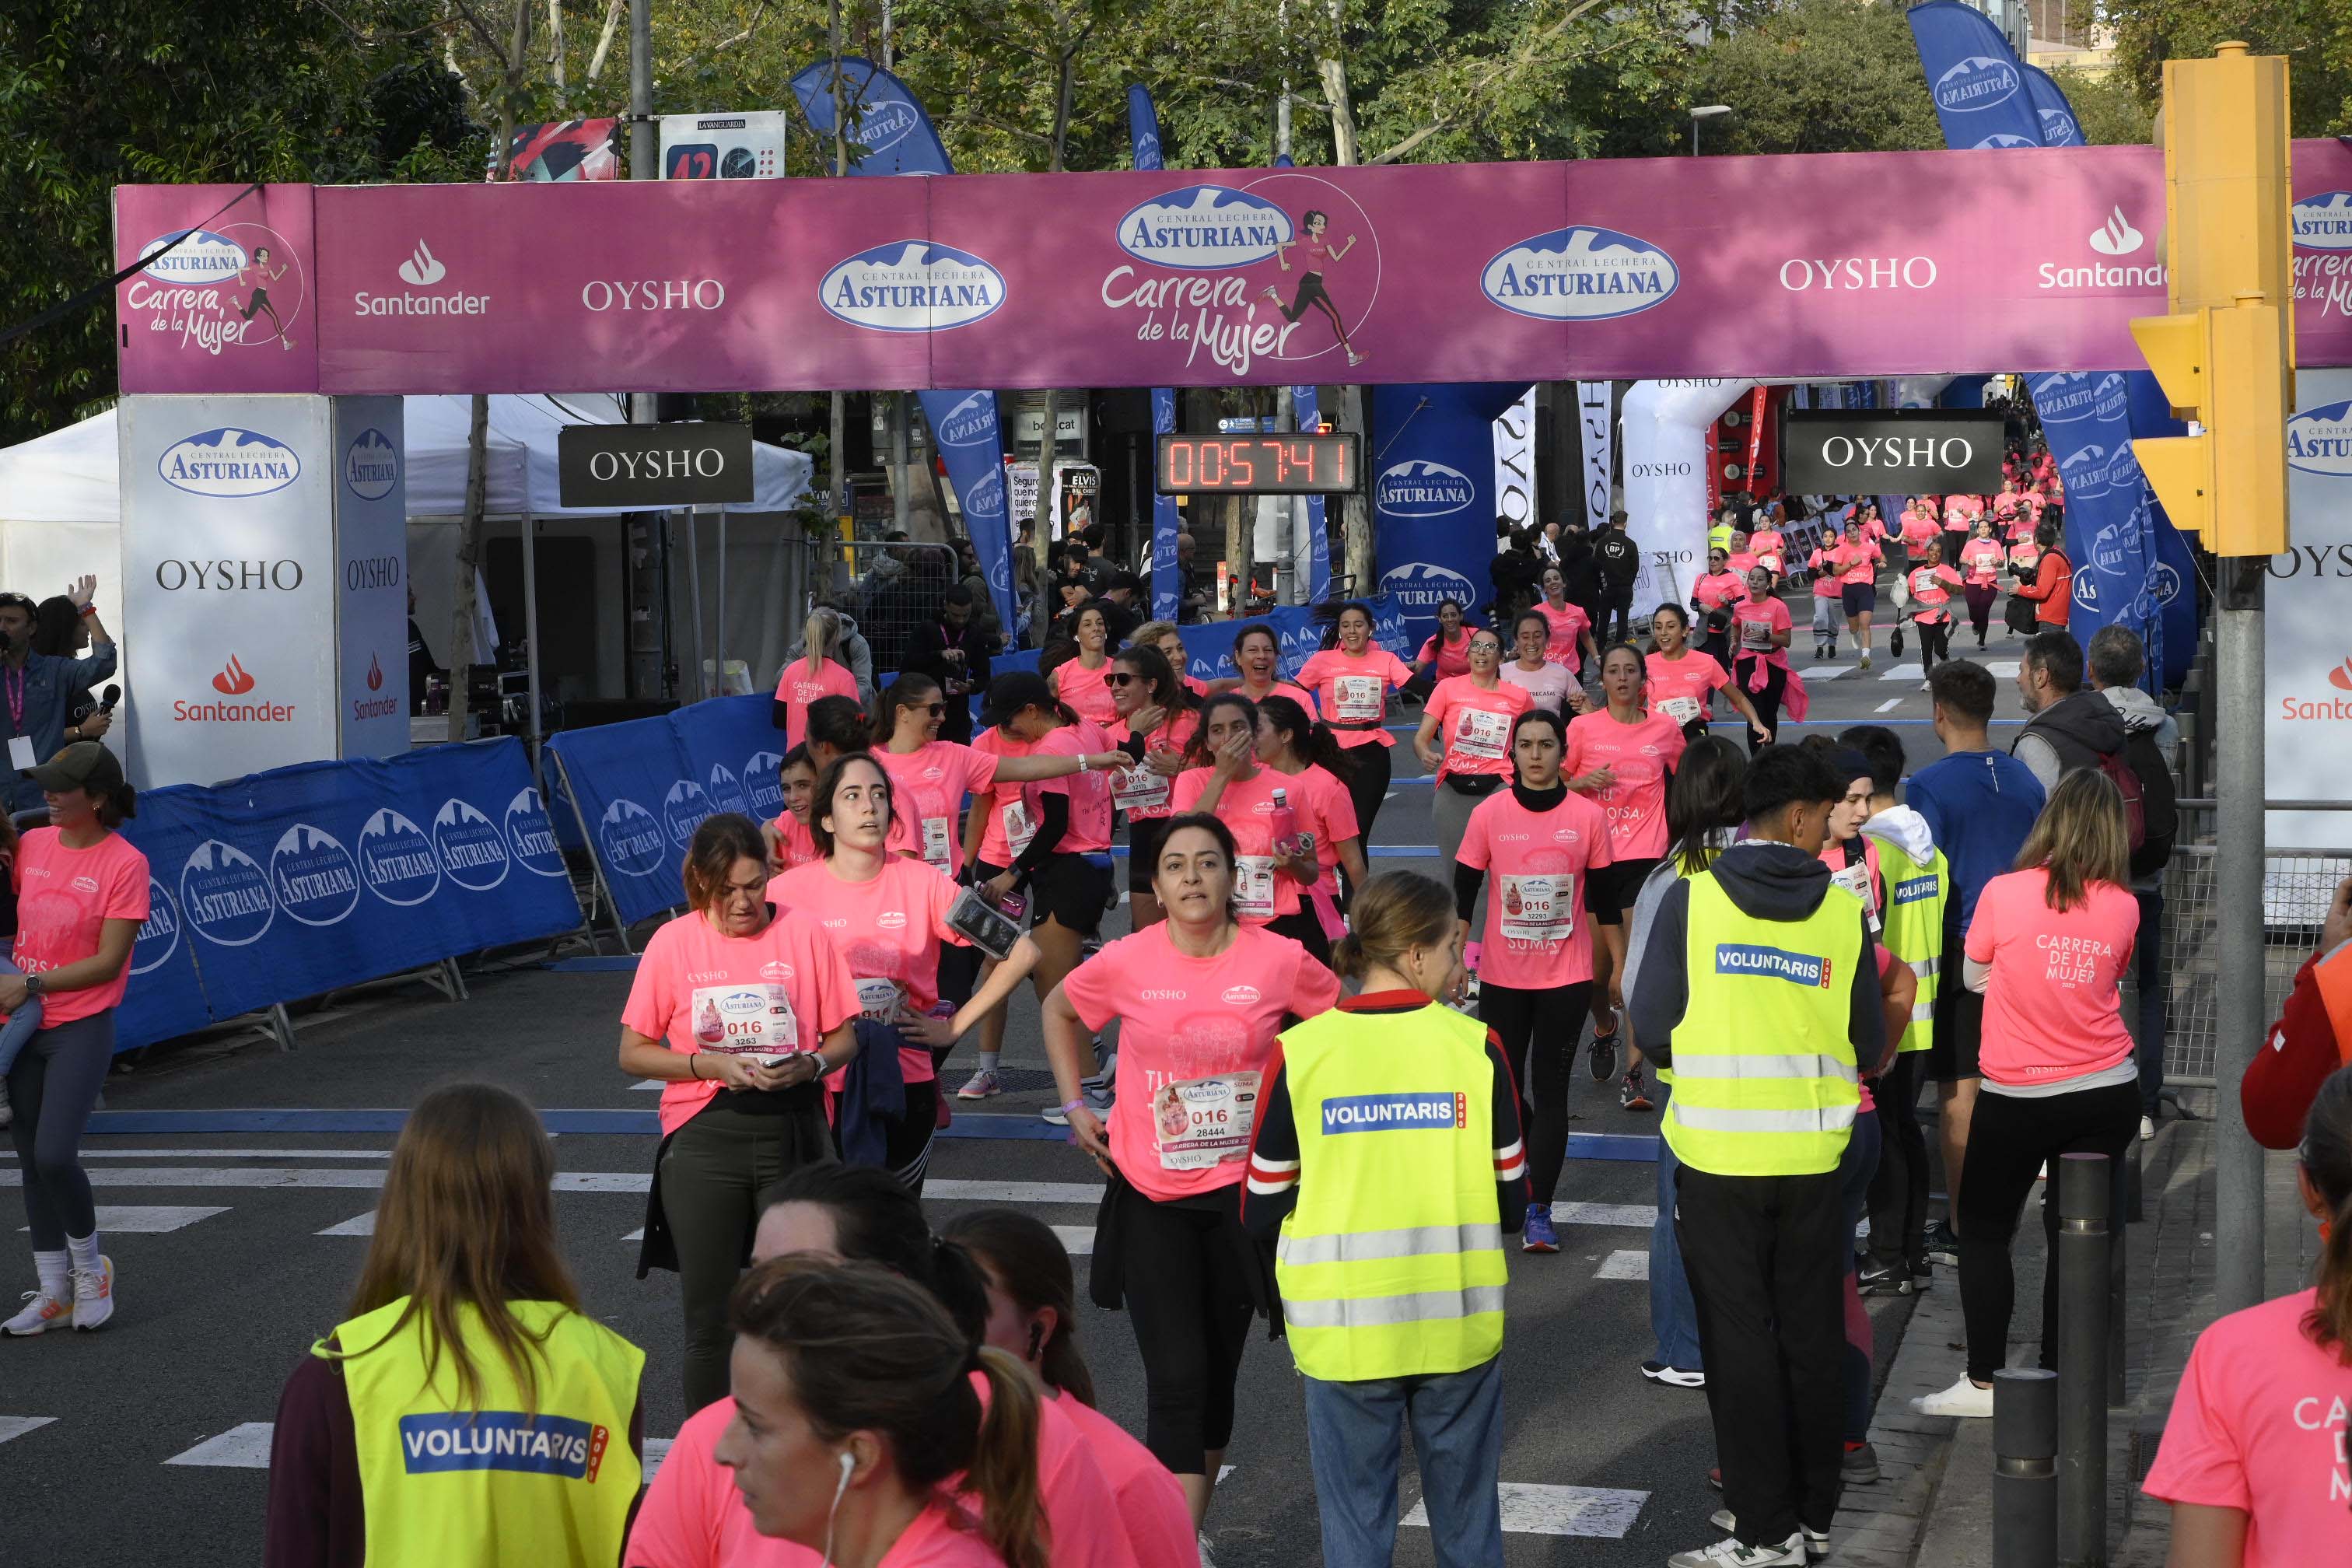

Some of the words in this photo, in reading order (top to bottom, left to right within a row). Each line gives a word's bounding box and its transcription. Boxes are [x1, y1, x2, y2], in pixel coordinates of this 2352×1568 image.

[1157, 215, 1212, 223] CENTRAL
[1219, 213, 1274, 222] LECHERA
[1130, 217, 1279, 249] ASTURIANA
[1528, 259, 1587, 268] CENTRAL
[1594, 257, 1657, 268] LECHERA
[1780, 257, 1937, 291] OYSHO
[863, 272, 921, 281] CENTRAL
[927, 271, 985, 280] LECHERA
[1101, 265, 1247, 309] Carrera
[1496, 263, 1664, 296] ASTURIANA
[128, 281, 219, 310] Carrera
[583, 279, 725, 311] OYSHO
[834, 275, 992, 308] ASTURIANA
[2311, 277, 2324, 299] la
[355, 291, 489, 316] Santander
[151, 311, 167, 331] de
[171, 311, 183, 331] la
[181, 307, 254, 355] Mujer
[1138, 311, 1164, 341] de
[1171, 310, 1189, 340] la
[1185, 303, 1301, 376] Mujer
[1822, 436, 1972, 468] OYSHO
[170, 453, 290, 480] ASTURIANA
[350, 456, 394, 483] ASTURIANA
[590, 448, 724, 481] OYSHO
[1632, 462, 1691, 478] OYSHO
[1073, 476, 1096, 486] ELVIS
[1379, 482, 1467, 505] ASTURIANA
[156, 559, 303, 591] OYSHO
[348, 555, 399, 591] OYSHO
[174, 700, 296, 723] Santander
[355, 695, 397, 722] Santander
[1474, 727, 1491, 737] 016
[1129, 774, 1148, 784] 016
[1500, 833, 1529, 842] OYSHO
[439, 835, 506, 871] ASTURIANA
[366, 848, 437, 885] ASTURIANA
[278, 866, 356, 906] ASTURIANA
[191, 884, 271, 926] ASTURIANA
[1525, 901, 1549, 911] 016
[822, 919, 846, 927] SHO
[2036, 934, 2112, 957] CARRERA
[1718, 950, 1818, 979] VOLUNTARIS
[2049, 950, 2070, 965] DE
[2076, 953, 2095, 969] LA
[2046, 966, 2095, 984] MUJER
[859, 992, 893, 1000] ASTURIANA
[1142, 989, 1186, 1001] OYSHO
[727, 1020, 762, 1034] 016
[1187, 1087, 1227, 1098] ASTURIANA
[1192, 1109, 1228, 1125] 016
[1325, 1102, 1452, 1125] VOLUNTARIS
[1196, 1127, 1225, 1137] 28444
[1172, 1142, 1199, 1150] CARRERA
[1171, 1155, 1202, 1164] OYSHO
[406, 1427, 587, 1464] VOLUNTARIS
